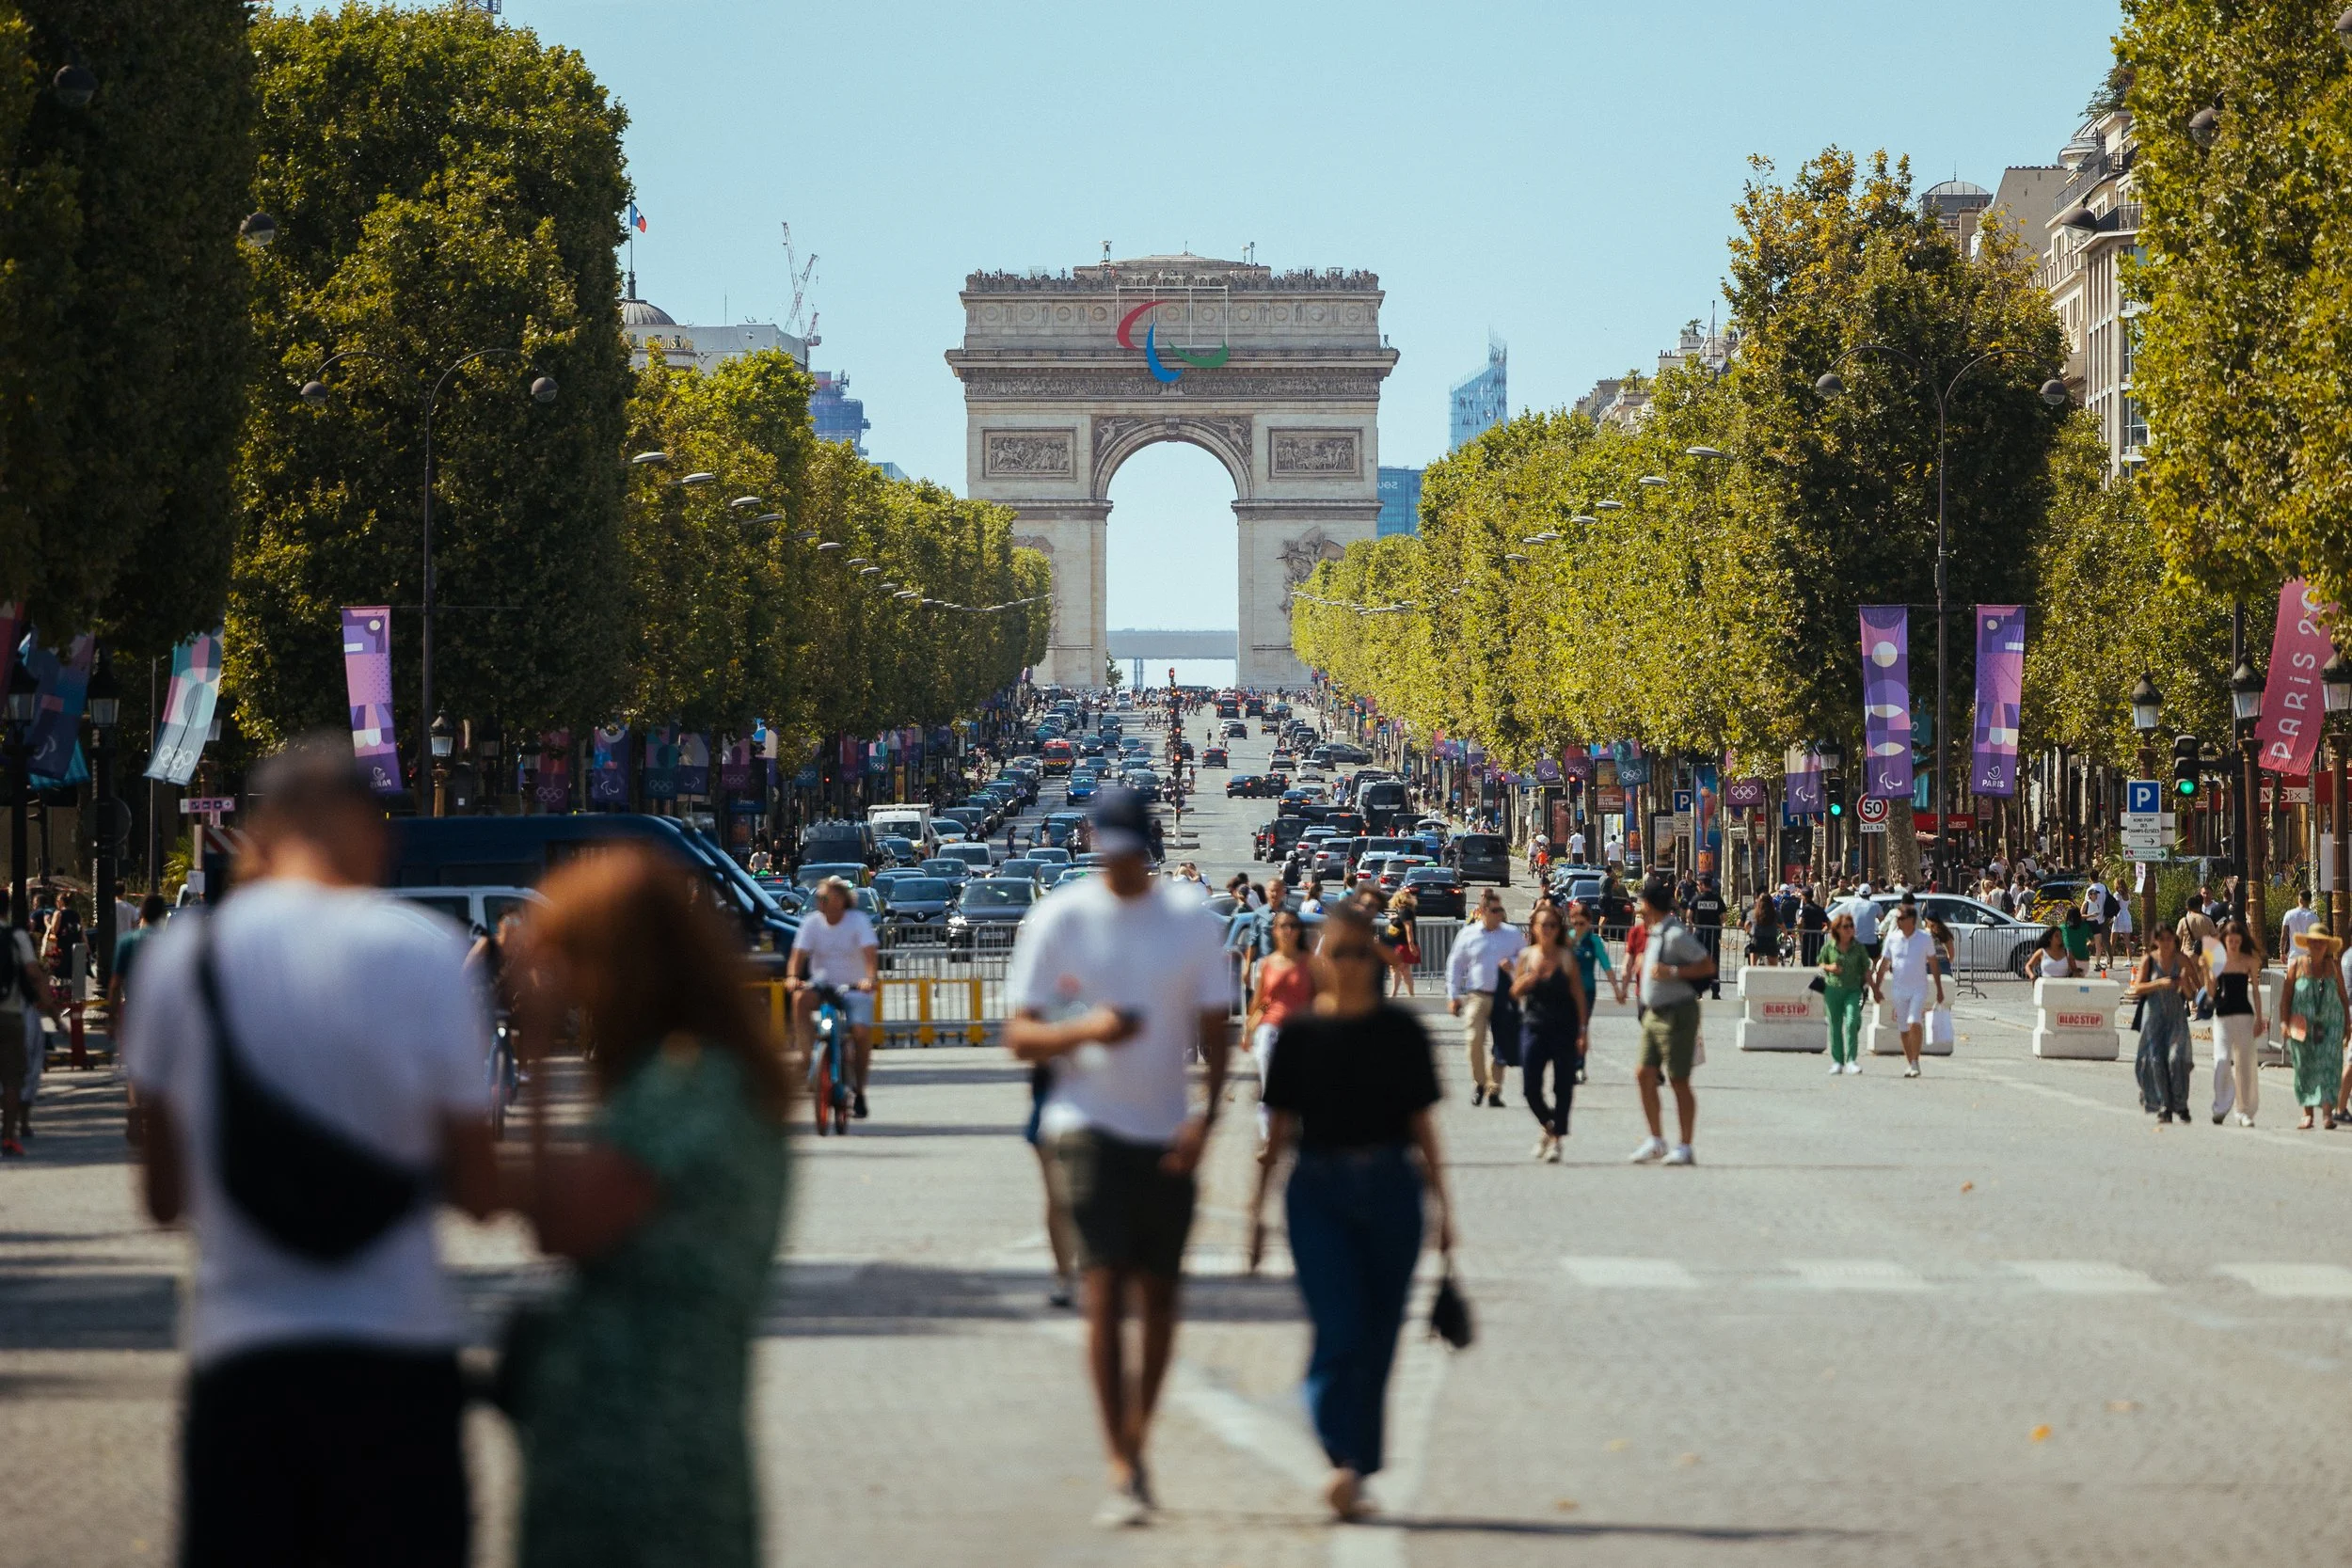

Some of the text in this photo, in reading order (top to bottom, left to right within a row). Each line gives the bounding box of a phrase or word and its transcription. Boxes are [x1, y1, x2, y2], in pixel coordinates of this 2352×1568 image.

[643, 337, 676, 349] LUIS
[1981, 779, 2005, 788] PARIS
[1679, 794, 1690, 809] P
[2137, 787, 2152, 808] P
[1864, 801, 1883, 815] 50
[1699, 901, 1717, 910] POLICE
[2059, 1015, 2101, 1025] BLOC STOP
